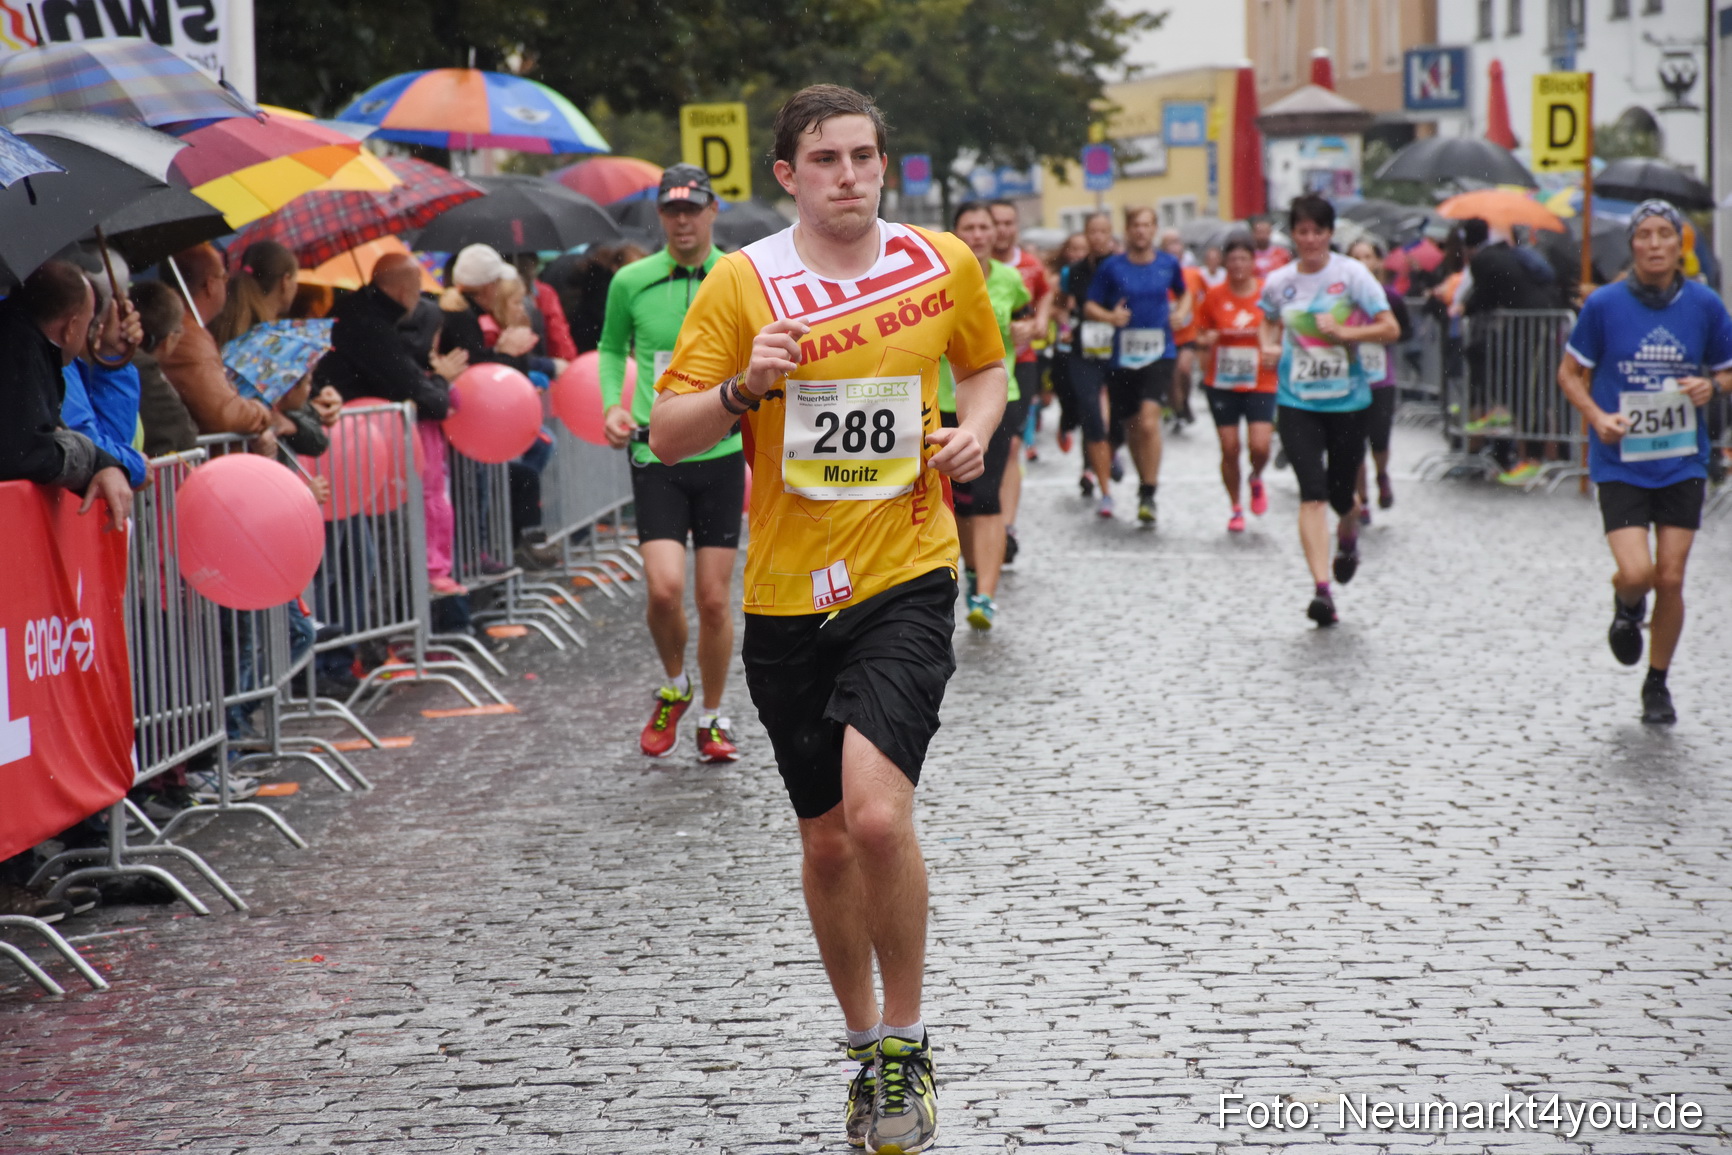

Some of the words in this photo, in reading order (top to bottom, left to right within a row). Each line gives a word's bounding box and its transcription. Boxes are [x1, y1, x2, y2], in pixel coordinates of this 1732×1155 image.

[1549, 104, 1577, 148] D
[702, 135, 732, 179] D
[874, 288, 955, 338] BÖGL
[1297, 361, 1342, 380] 2467
[797, 394, 839, 403] NeuerMarkt
[846, 382, 909, 398] BOCK
[813, 408, 896, 454] 288
[1629, 404, 1687, 434] 2541
[824, 466, 878, 482] Moritz
